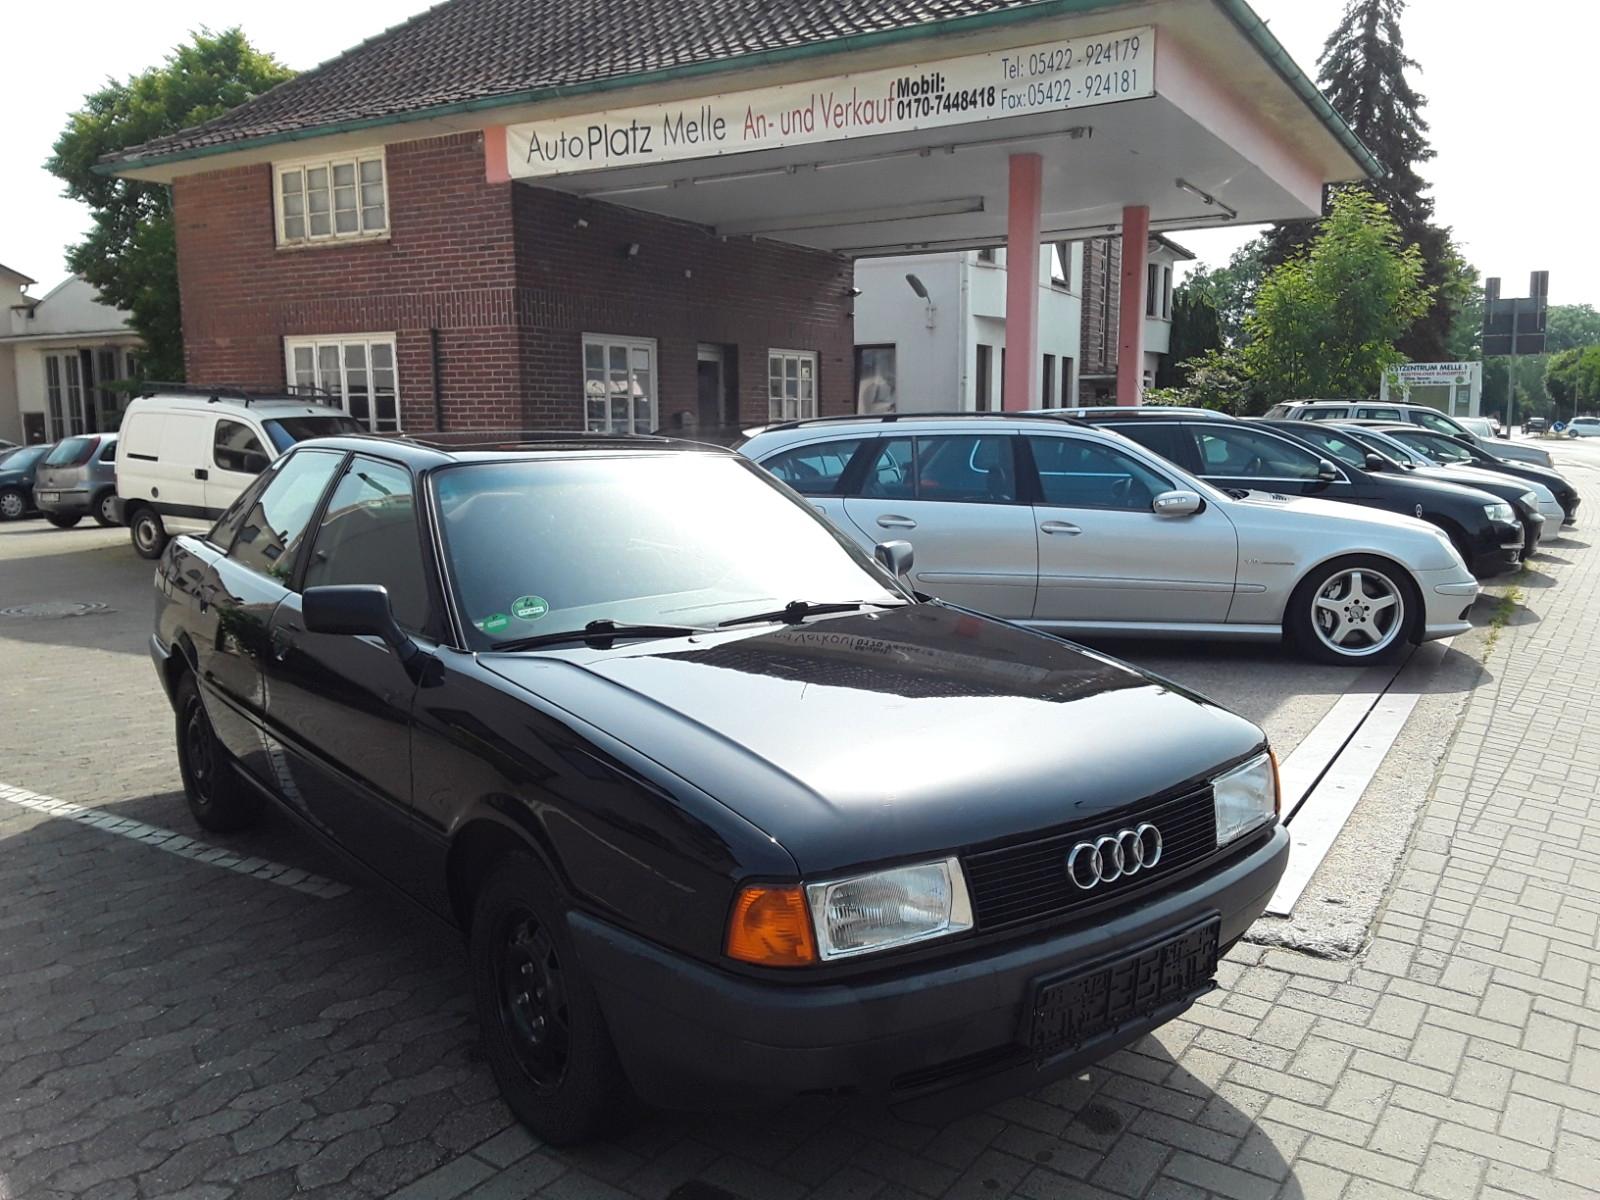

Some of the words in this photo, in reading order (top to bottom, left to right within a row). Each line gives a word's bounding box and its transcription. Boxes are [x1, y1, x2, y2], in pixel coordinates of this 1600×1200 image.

[1002, 55, 1024, 80] Tel:
[1029, 48, 1073, 76] 05422
[1086, 36, 1140, 66] 924179
[897, 72, 945, 98] Mobil:
[897, 86, 995, 120] 0170-7448418
[1001, 88, 1026, 110] Fax:
[1028, 78, 1071, 106] 05422
[1085, 69, 1137, 98] 924181
[527, 119, 652, 163] AutoPlatz
[664, 104, 726, 146] Melle
[743, 103, 774, 141] An-
[780, 94, 815, 135] und
[820, 81, 895, 129] Verkauf
[1440, 363, 1462, 371] MELLE
